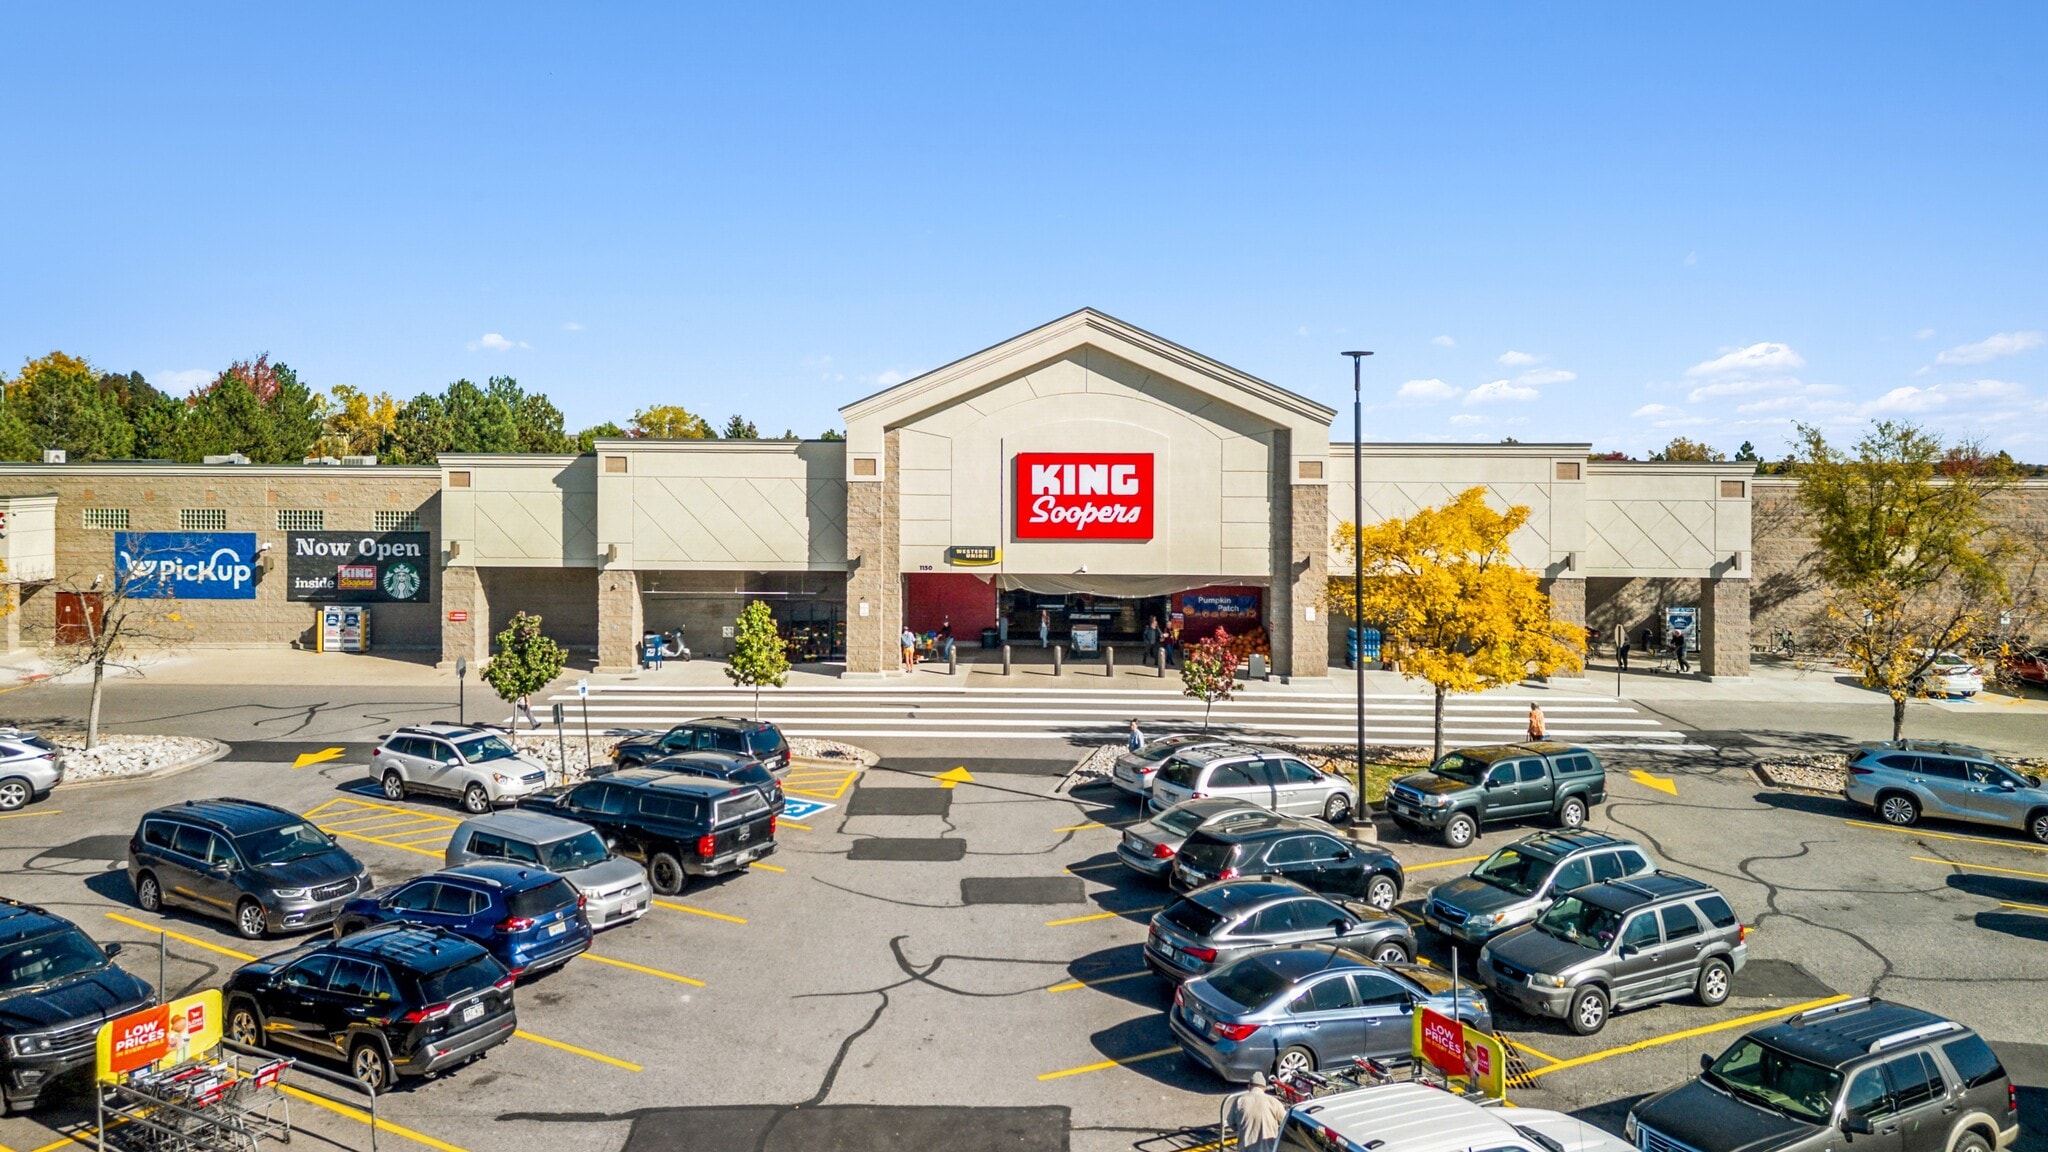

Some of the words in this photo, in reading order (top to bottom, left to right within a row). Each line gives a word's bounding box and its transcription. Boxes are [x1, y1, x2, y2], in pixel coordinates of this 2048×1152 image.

[1031, 464, 1139, 495] KING
[1029, 495, 1141, 531] Soopers
[295, 537, 351, 556] Now
[358, 537, 421, 561] Open
[295, 577, 334, 589] inside
[341, 568, 373, 578] KING
[1198, 596, 1232, 605] Pumpkin
[116, 1028, 165, 1052] PRICES
[125, 1020, 158, 1039] LOW
[1425, 1027, 1462, 1054] PRICES
[1431, 1021, 1455, 1041] LOW
